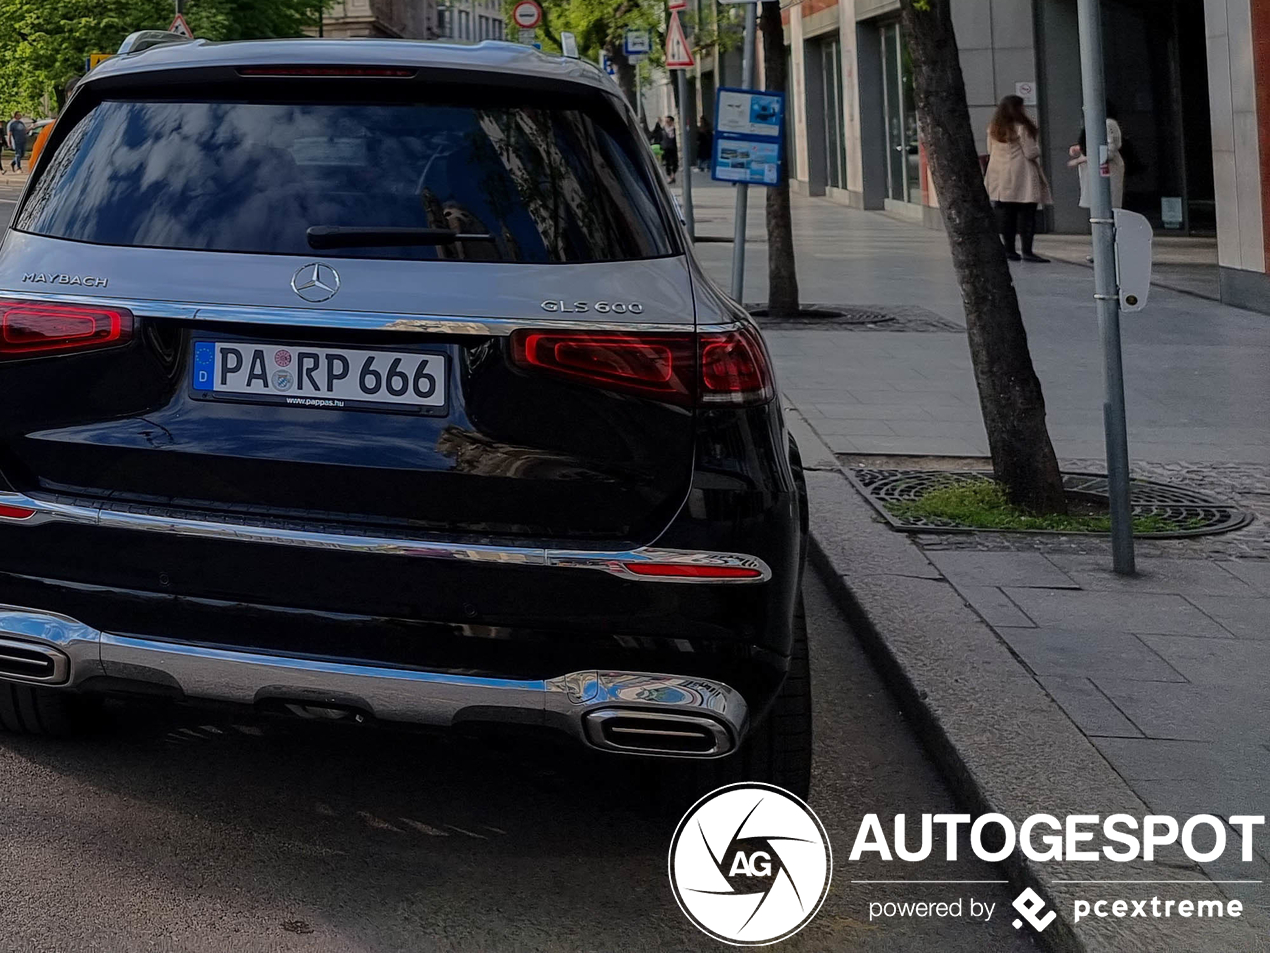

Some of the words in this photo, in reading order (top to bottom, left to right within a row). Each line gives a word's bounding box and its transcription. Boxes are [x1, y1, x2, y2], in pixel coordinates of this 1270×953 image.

[22, 272, 108, 288] MAYBACH
[540, 299, 590, 313] GLS
[594, 300, 644, 314] 600
[198, 370, 208, 382] D
[219, 347, 269, 389] PA
[296, 351, 350, 392] RP
[358, 356, 437, 398] 666
[286, 397, 345, 407] www.pappas.hu
